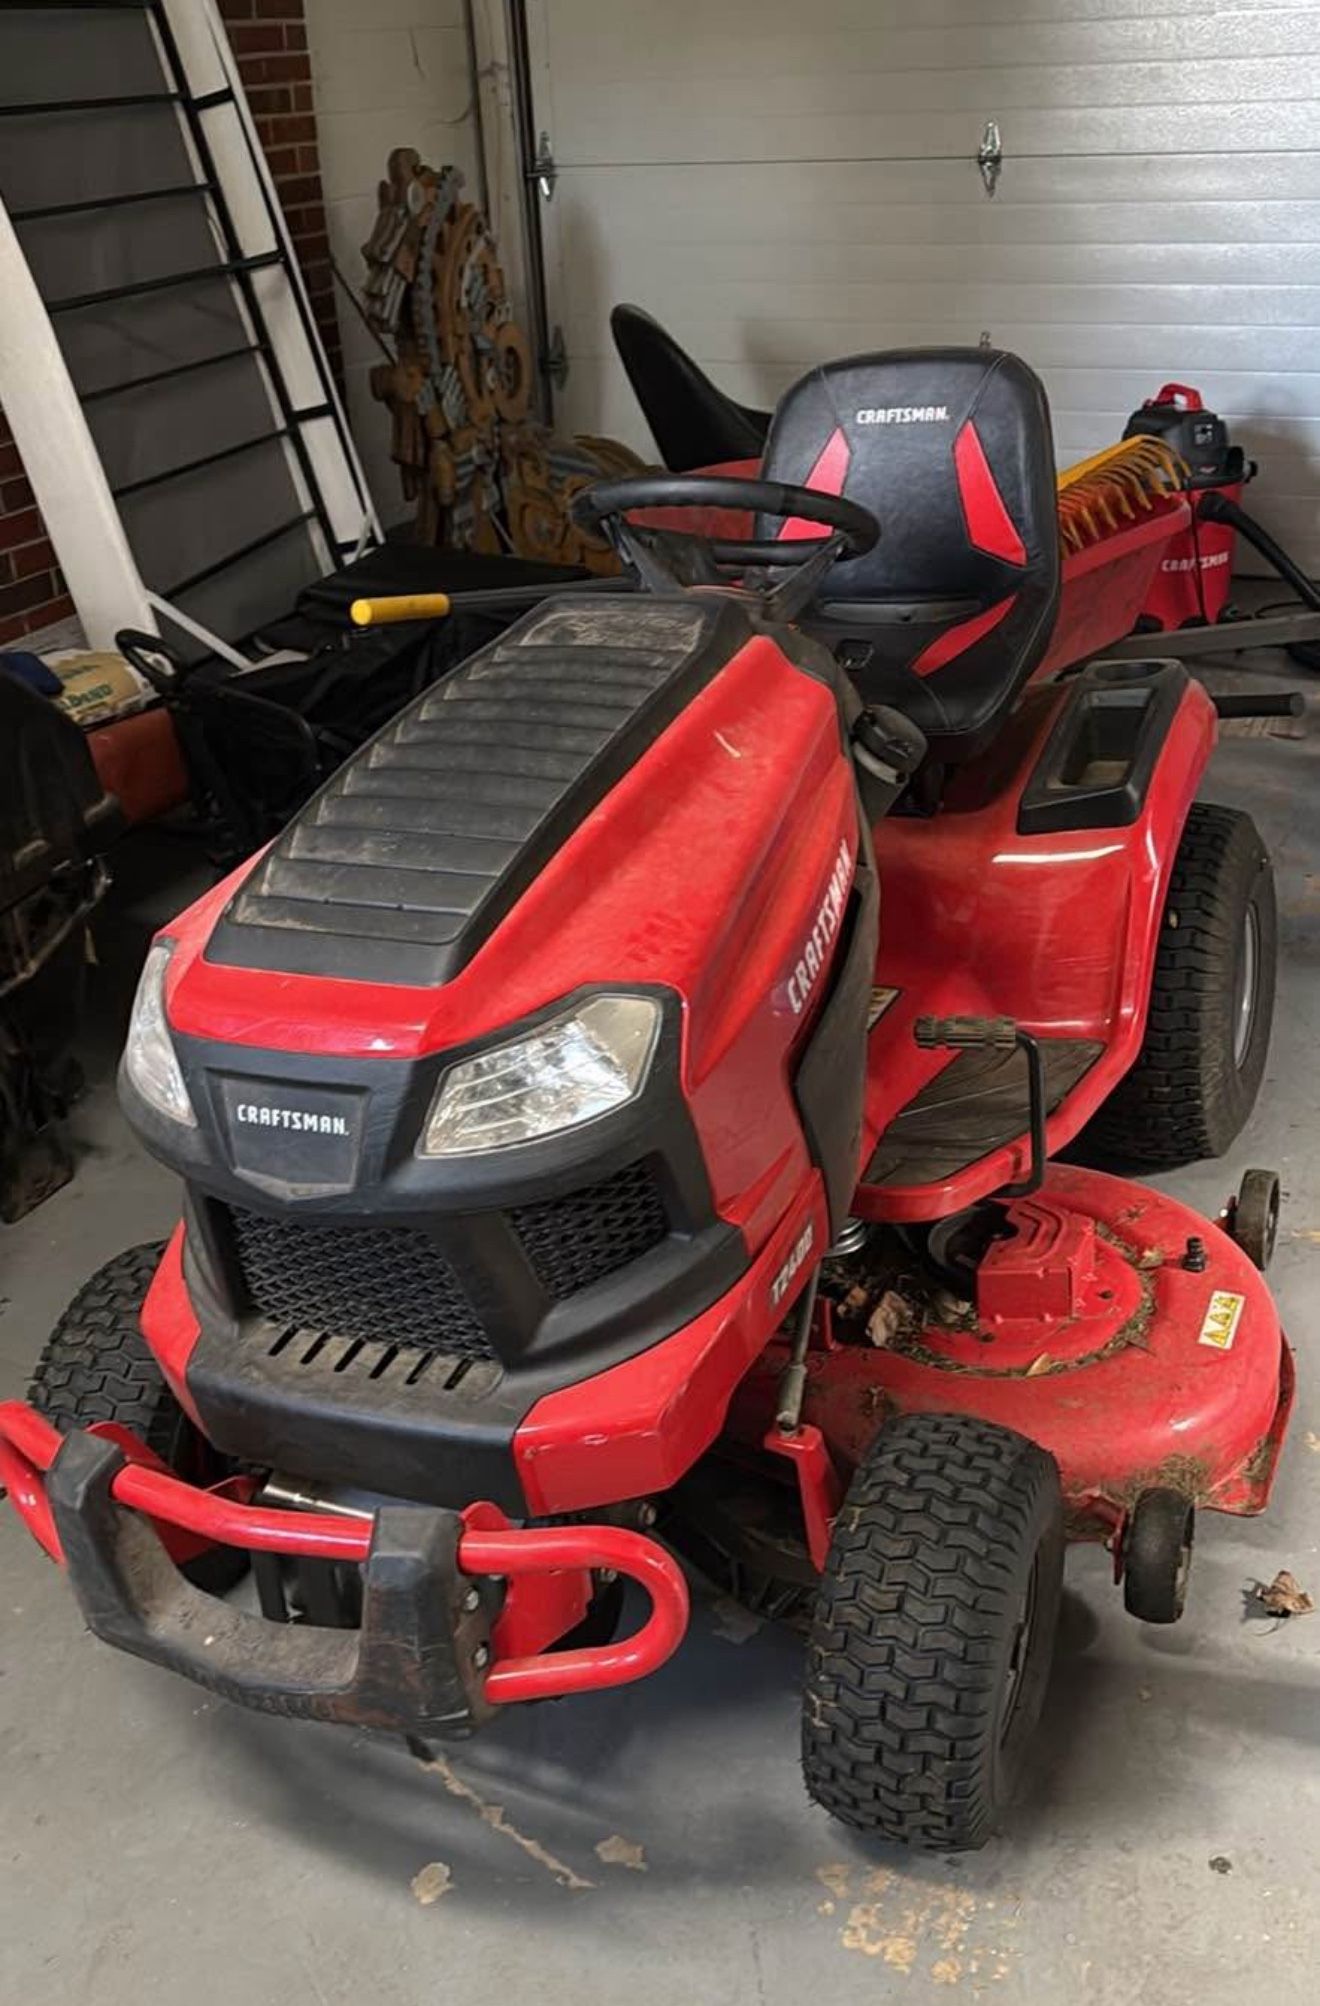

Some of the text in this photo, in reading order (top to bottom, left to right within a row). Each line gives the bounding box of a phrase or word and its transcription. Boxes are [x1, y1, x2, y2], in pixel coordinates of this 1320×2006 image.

[856, 406, 948, 424] CRAFTSMAN
[1162, 551, 1229, 572] CRAFSMAN
[787, 838, 851, 1014] CRAFTSMAN
[237, 1104, 346, 1135] CRAFTSMAN
